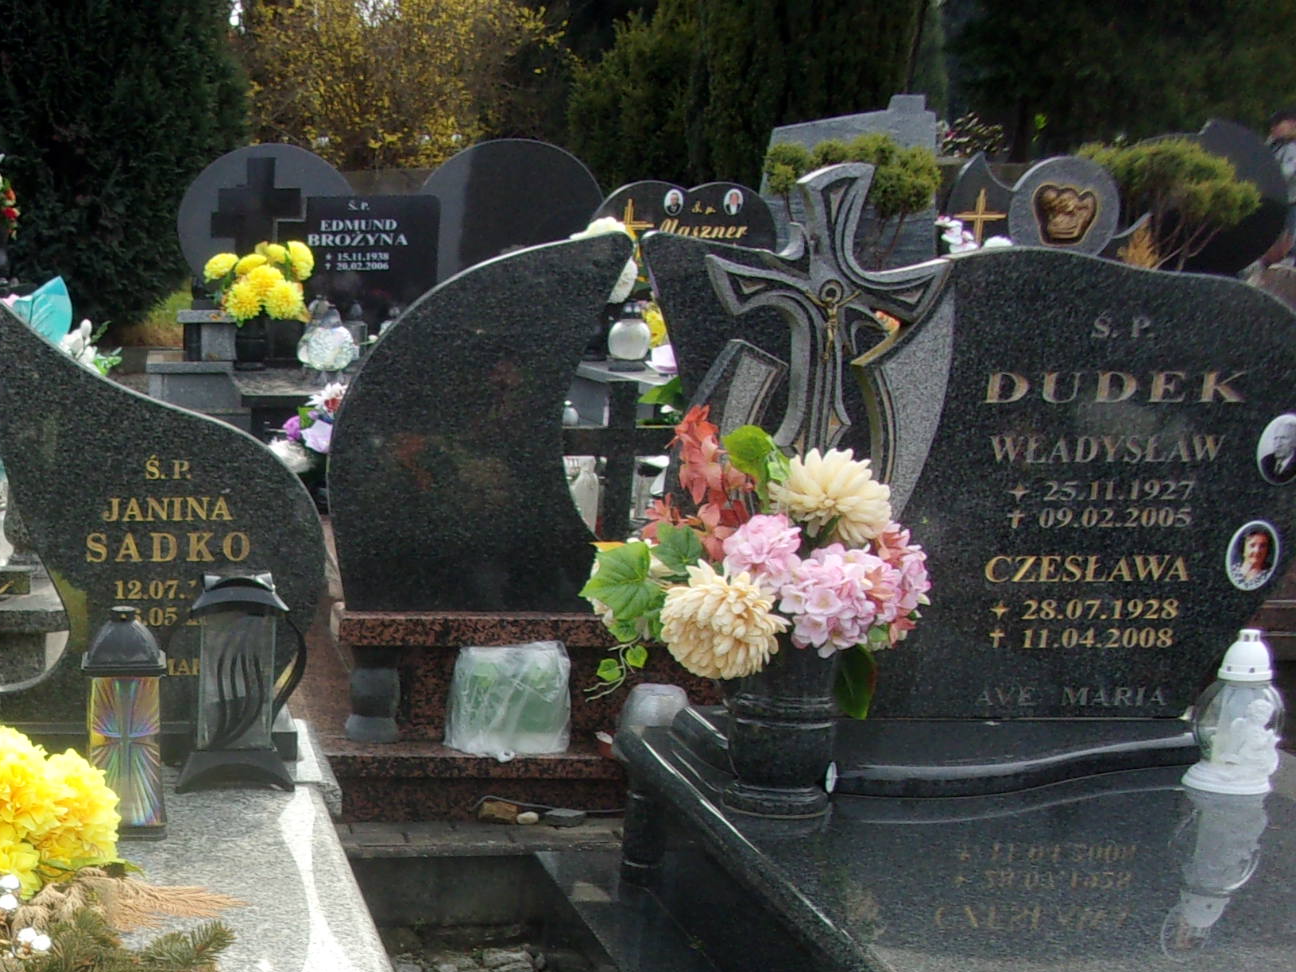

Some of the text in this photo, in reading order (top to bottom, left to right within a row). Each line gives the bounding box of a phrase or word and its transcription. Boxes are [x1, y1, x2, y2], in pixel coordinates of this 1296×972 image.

[320, 219, 398, 232] EDMUND
[307, 231, 409, 246] BROŻYNA
[1130, 315, 1155, 338] P.
[984, 370, 1248, 404] DUDEK
[990, 434, 1226, 464] WŁADYSŁAW
[144, 455, 193, 481] Ś. P.
[1043, 479, 1196, 501] 25.11.1927
[103, 496, 234, 523] JANINA
[1037, 506, 1193, 529] 09.02.2005
[86, 531, 251, 563] SADKO
[984, 554, 1190, 584] CZESŁAWA
[1019, 598, 1180, 621] 28.07.1928
[1022, 627, 1175, 649] 11.04.2008
[976, 686, 1170, 708] AVE MARIA
